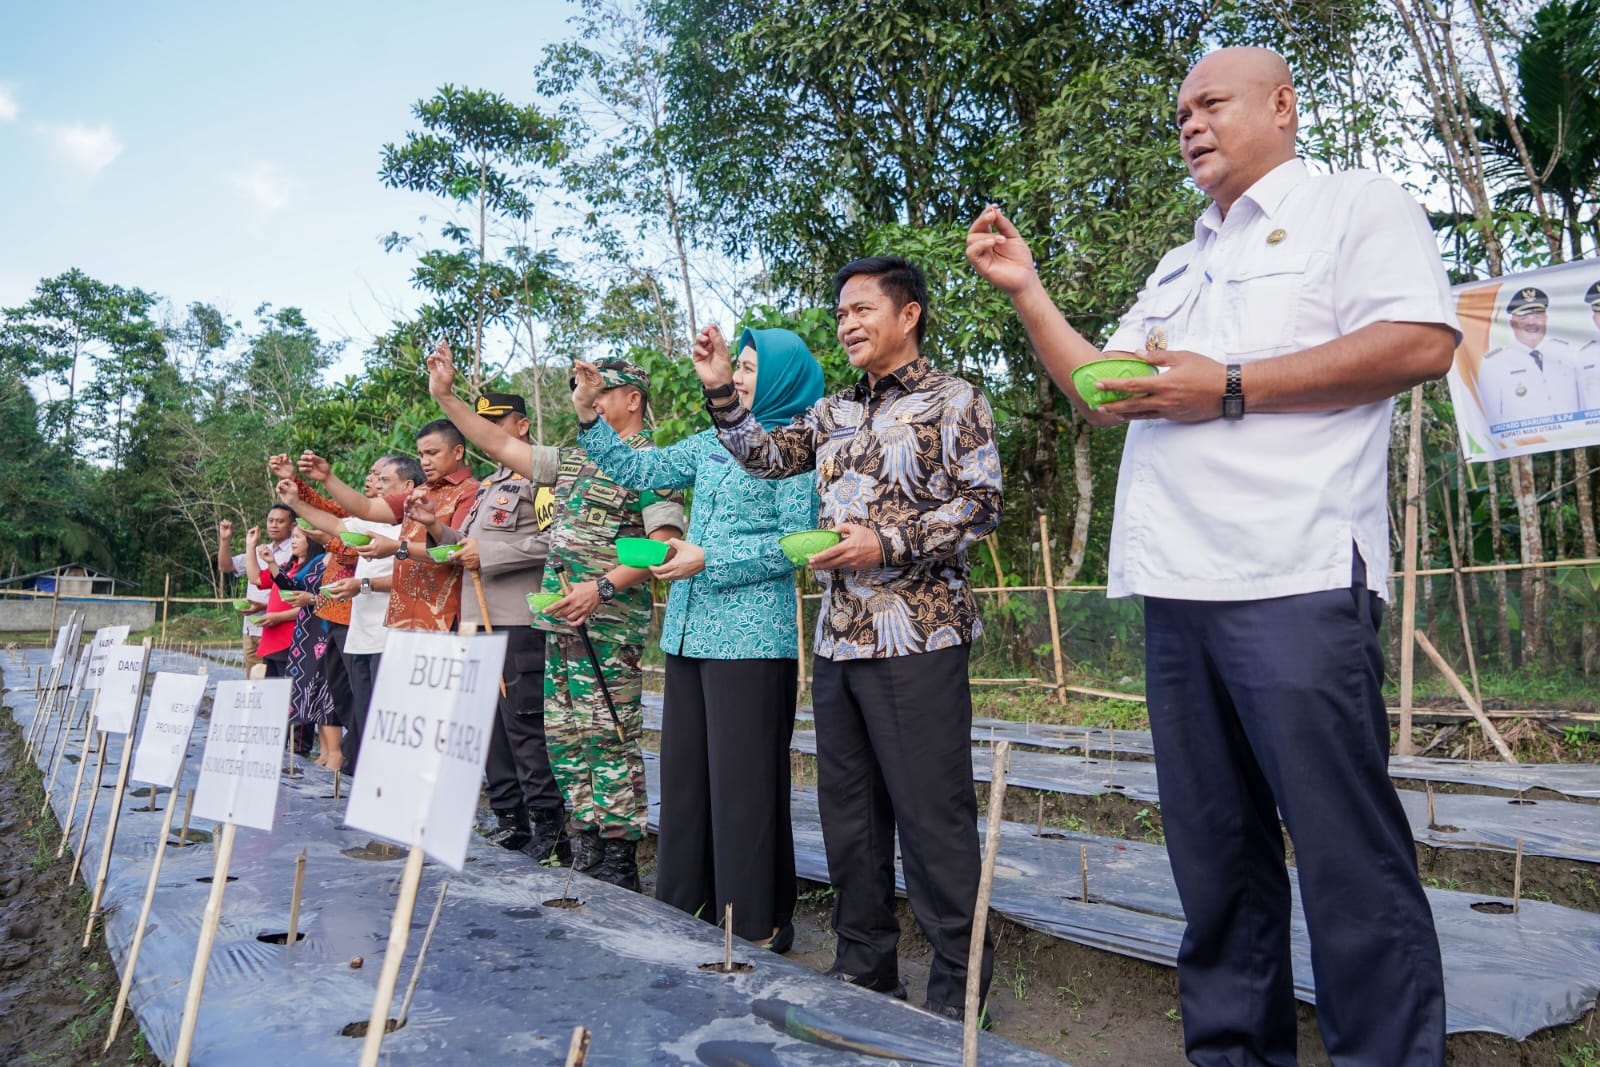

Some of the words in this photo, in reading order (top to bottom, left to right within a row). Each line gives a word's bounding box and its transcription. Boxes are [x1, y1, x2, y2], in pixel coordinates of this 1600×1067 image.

[1523, 427, 1538, 435] NIAS
[1539, 424, 1562, 433] UTARA
[371, 709, 425, 749] NIAS
